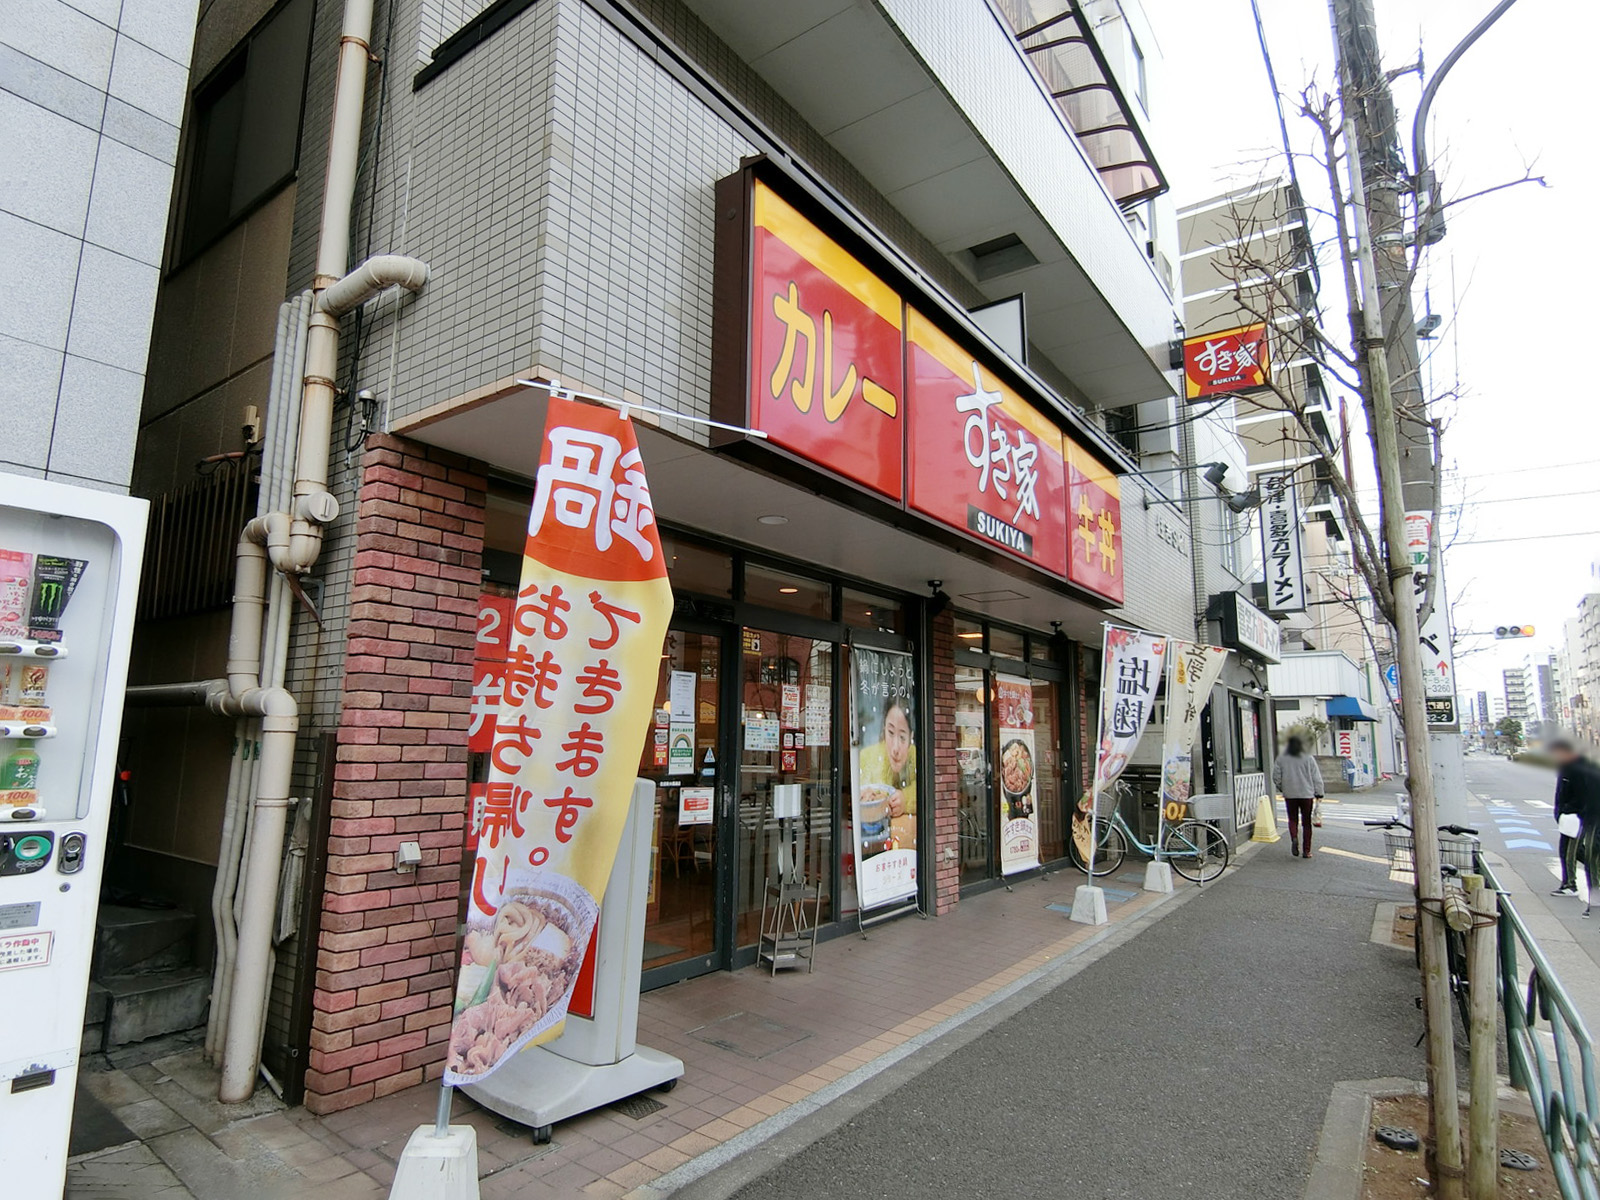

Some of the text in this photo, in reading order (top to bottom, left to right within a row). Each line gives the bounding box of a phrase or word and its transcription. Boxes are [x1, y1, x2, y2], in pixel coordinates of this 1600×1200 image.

[770, 280, 898, 424] カレー
[1193, 340, 1258, 376] すき家
[1212, 376, 1241, 386] SUKIYA
[955, 360, 1041, 525] すき家
[976, 511, 1026, 553] SUKIYA
[1077, 493, 1117, 578] 牛丼
[0, 937, 39, 948] ラ作動中
